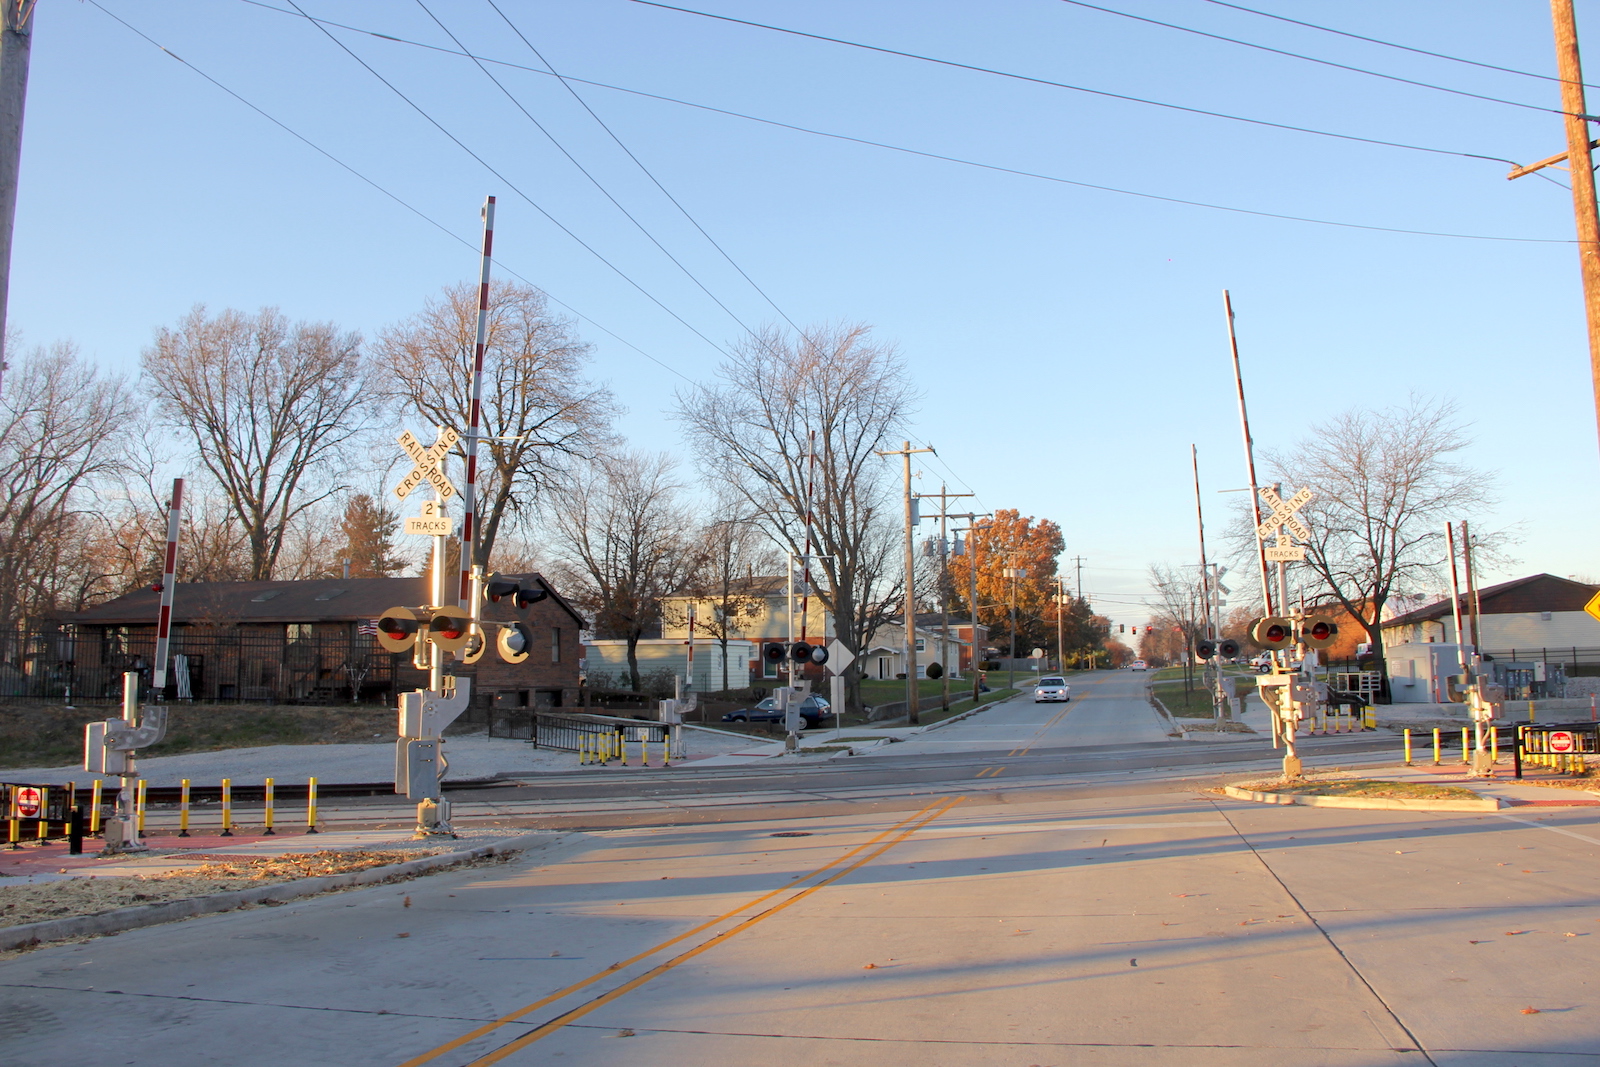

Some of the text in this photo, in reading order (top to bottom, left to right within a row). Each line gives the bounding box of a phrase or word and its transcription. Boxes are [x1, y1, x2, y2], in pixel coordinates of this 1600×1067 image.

[396, 432, 456, 497] CROSSING
[401, 432, 452, 497] RAIL ROAD
[425, 502, 433, 515] 2
[1258, 490, 1310, 536] CROSSING
[1260, 487, 1307, 539] RAIL ROAD
[411, 521, 447, 530] TRACKS
[1270, 550, 1299, 558] TRACKS
[1280, 536, 1287, 546] 2
